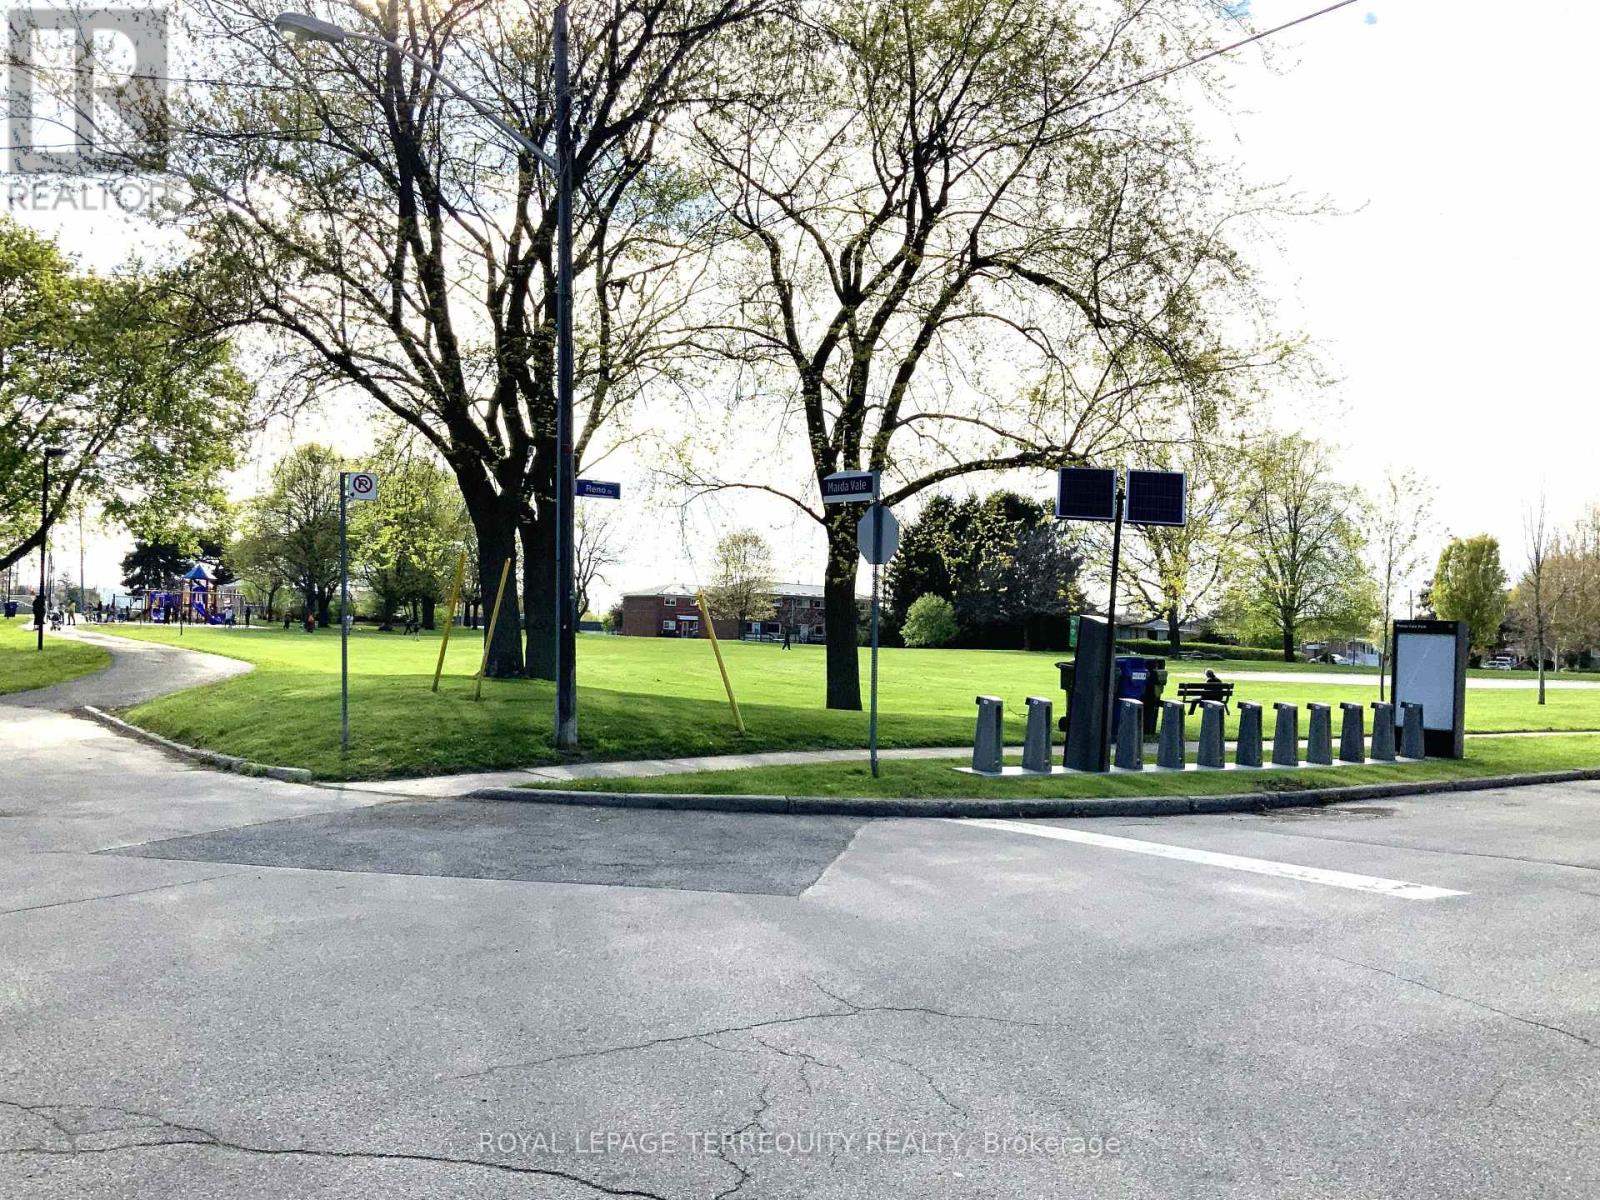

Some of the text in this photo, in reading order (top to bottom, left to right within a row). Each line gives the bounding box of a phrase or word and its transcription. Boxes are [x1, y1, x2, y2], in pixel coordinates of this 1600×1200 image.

[585, 484, 606, 494] Reno
[827, 479, 867, 493] Maida Vale
